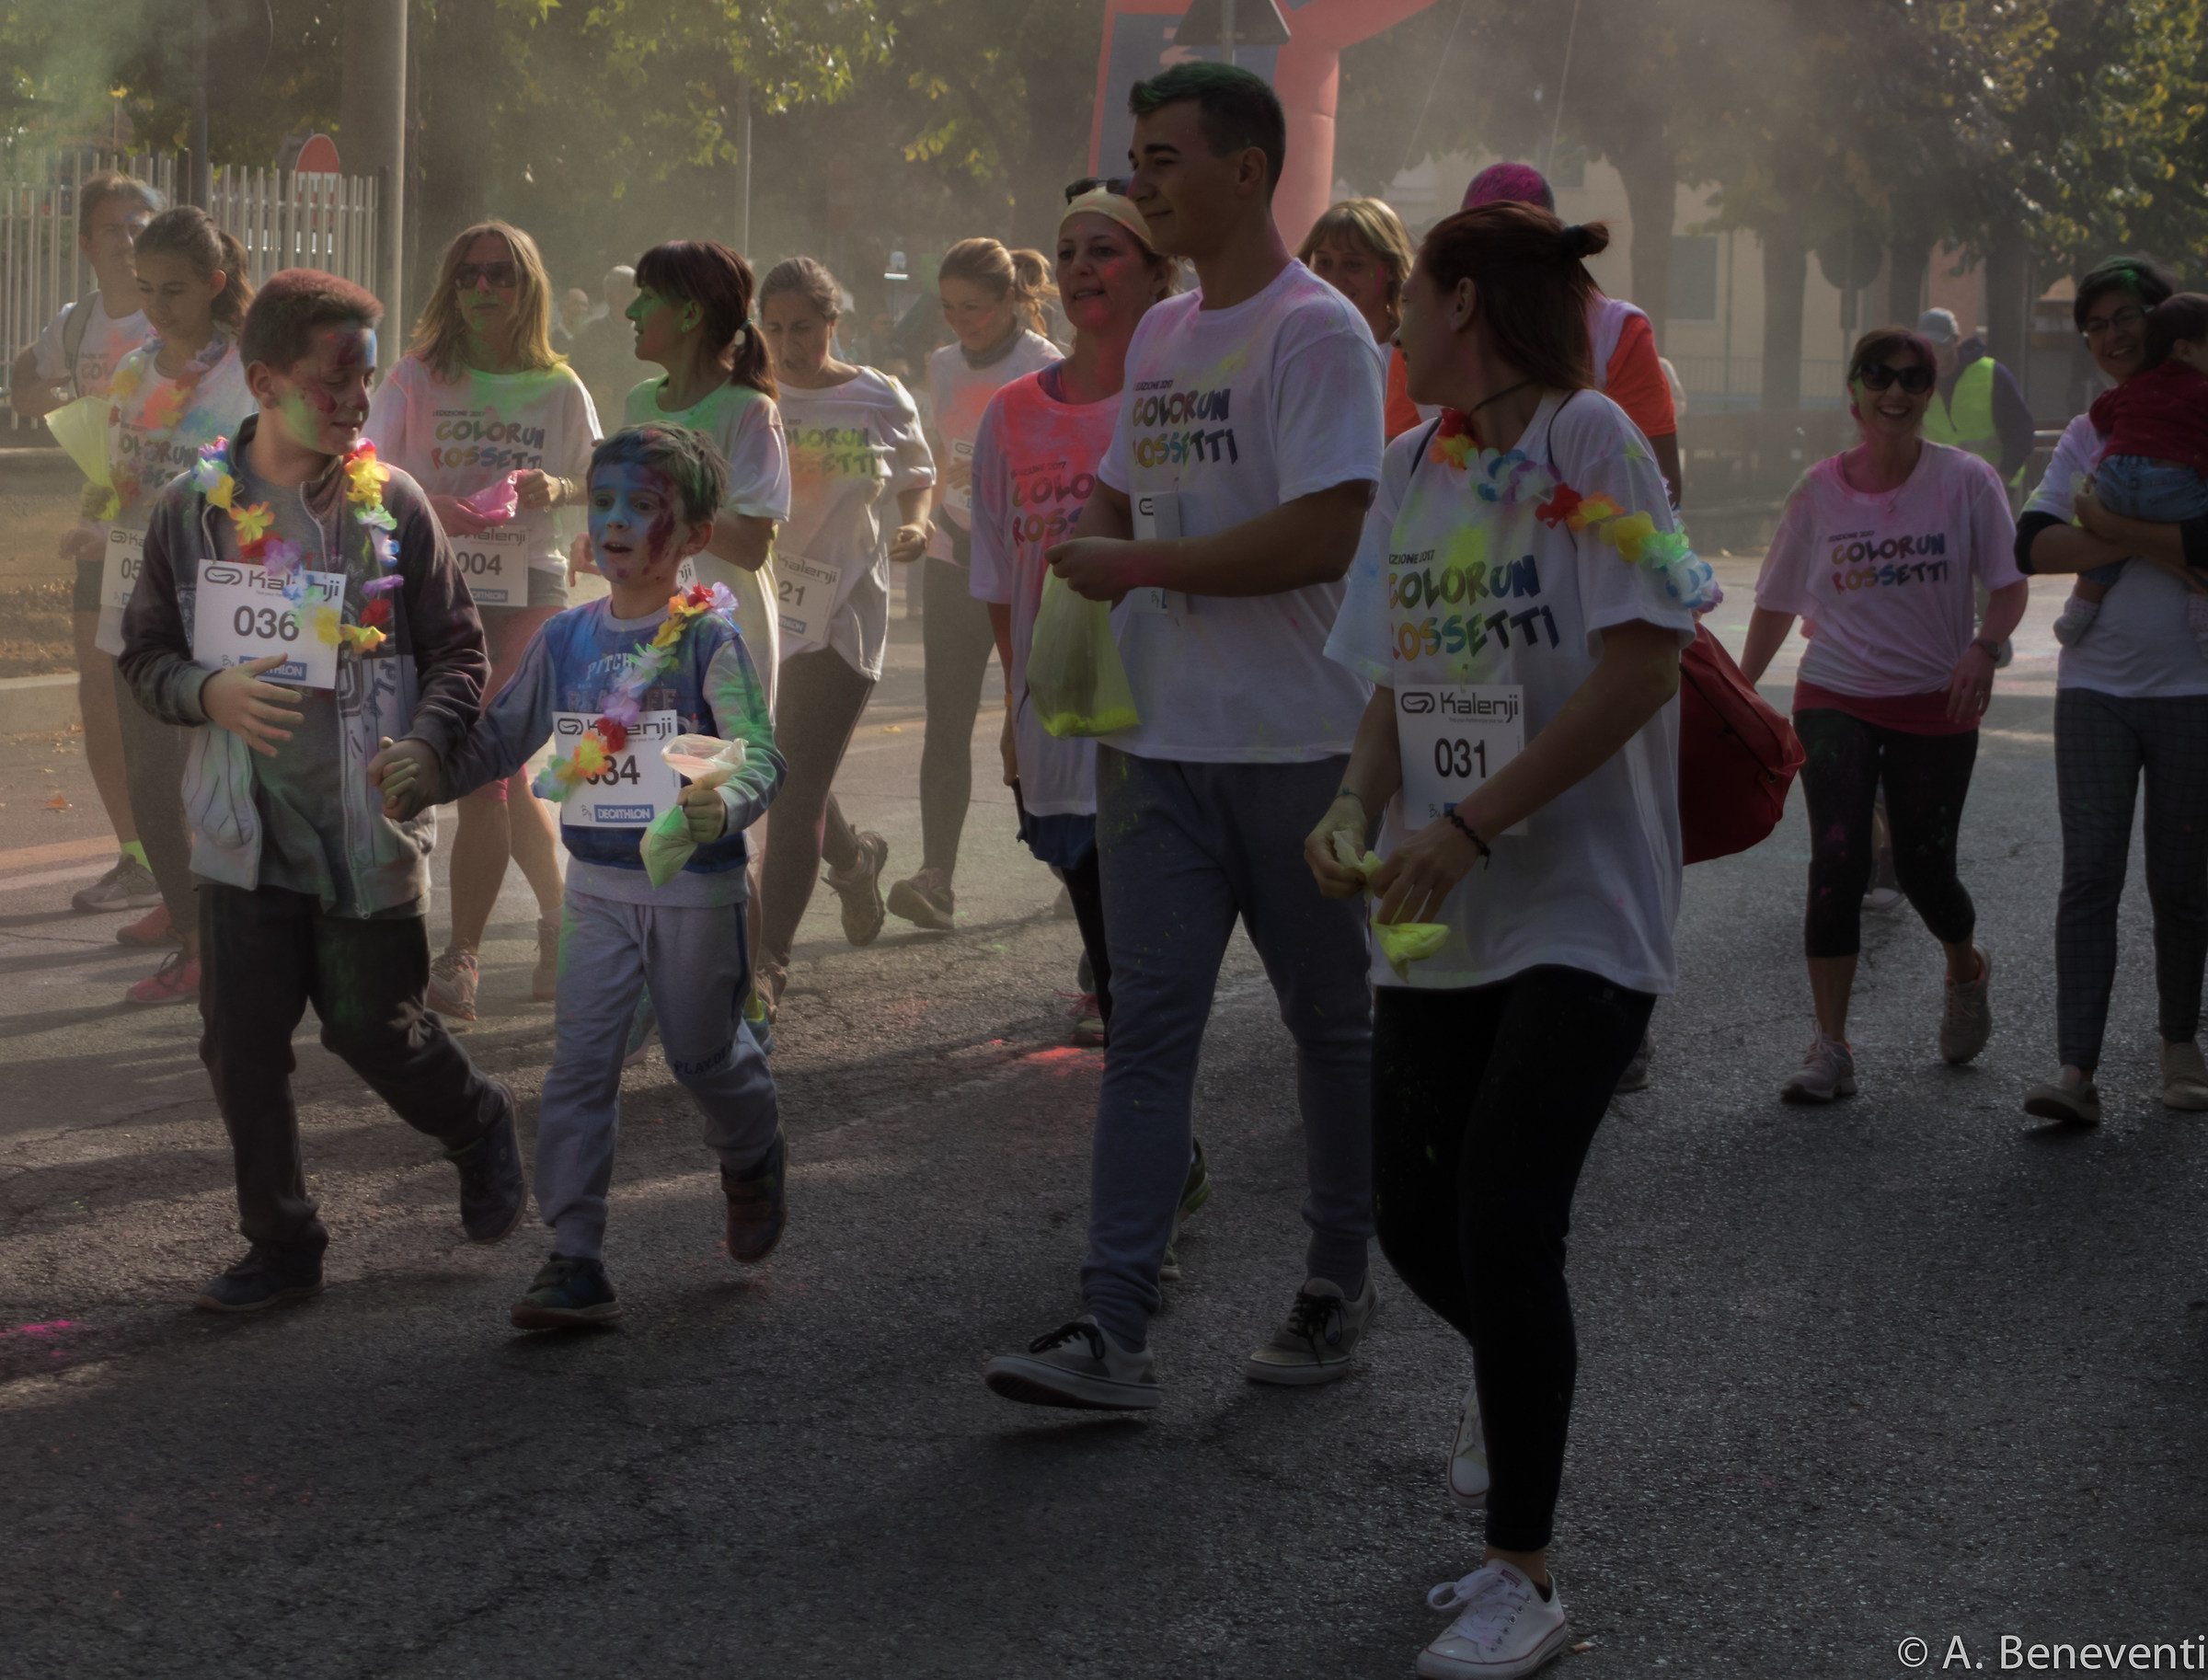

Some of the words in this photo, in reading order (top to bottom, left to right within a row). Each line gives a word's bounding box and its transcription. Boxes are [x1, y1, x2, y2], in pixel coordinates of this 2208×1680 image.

[1133, 387, 1231, 427] COLORUN
[119, 433, 200, 467] OLORUN
[435, 420, 546, 449] COLORUN
[1133, 428, 1238, 468] OSSETTI
[431, 445, 543, 471] ROSSETTI
[1013, 472, 1096, 507] COLO
[472, 528, 526, 547] alenji
[1831, 532, 1946, 565] COLORUN
[121, 557, 142, 581] 05
[456, 551, 503, 576] 004
[1388, 552, 1420, 565] IZIONE
[248, 570, 340, 602] Kalnji
[1388, 555, 1541, 610] COLORUN
[1833, 559, 1948, 594] ROSSETTI
[778, 580, 806, 607] 21
[234, 604, 300, 641] 036
[587, 651, 637, 681] PITCH
[1440, 692, 1519, 723] Kalenji
[587, 718, 672, 741] Kenji
[585, 754, 641, 786] 34
[1434, 738, 1487, 778] 031
[597, 808, 651, 821] DECATHLON
